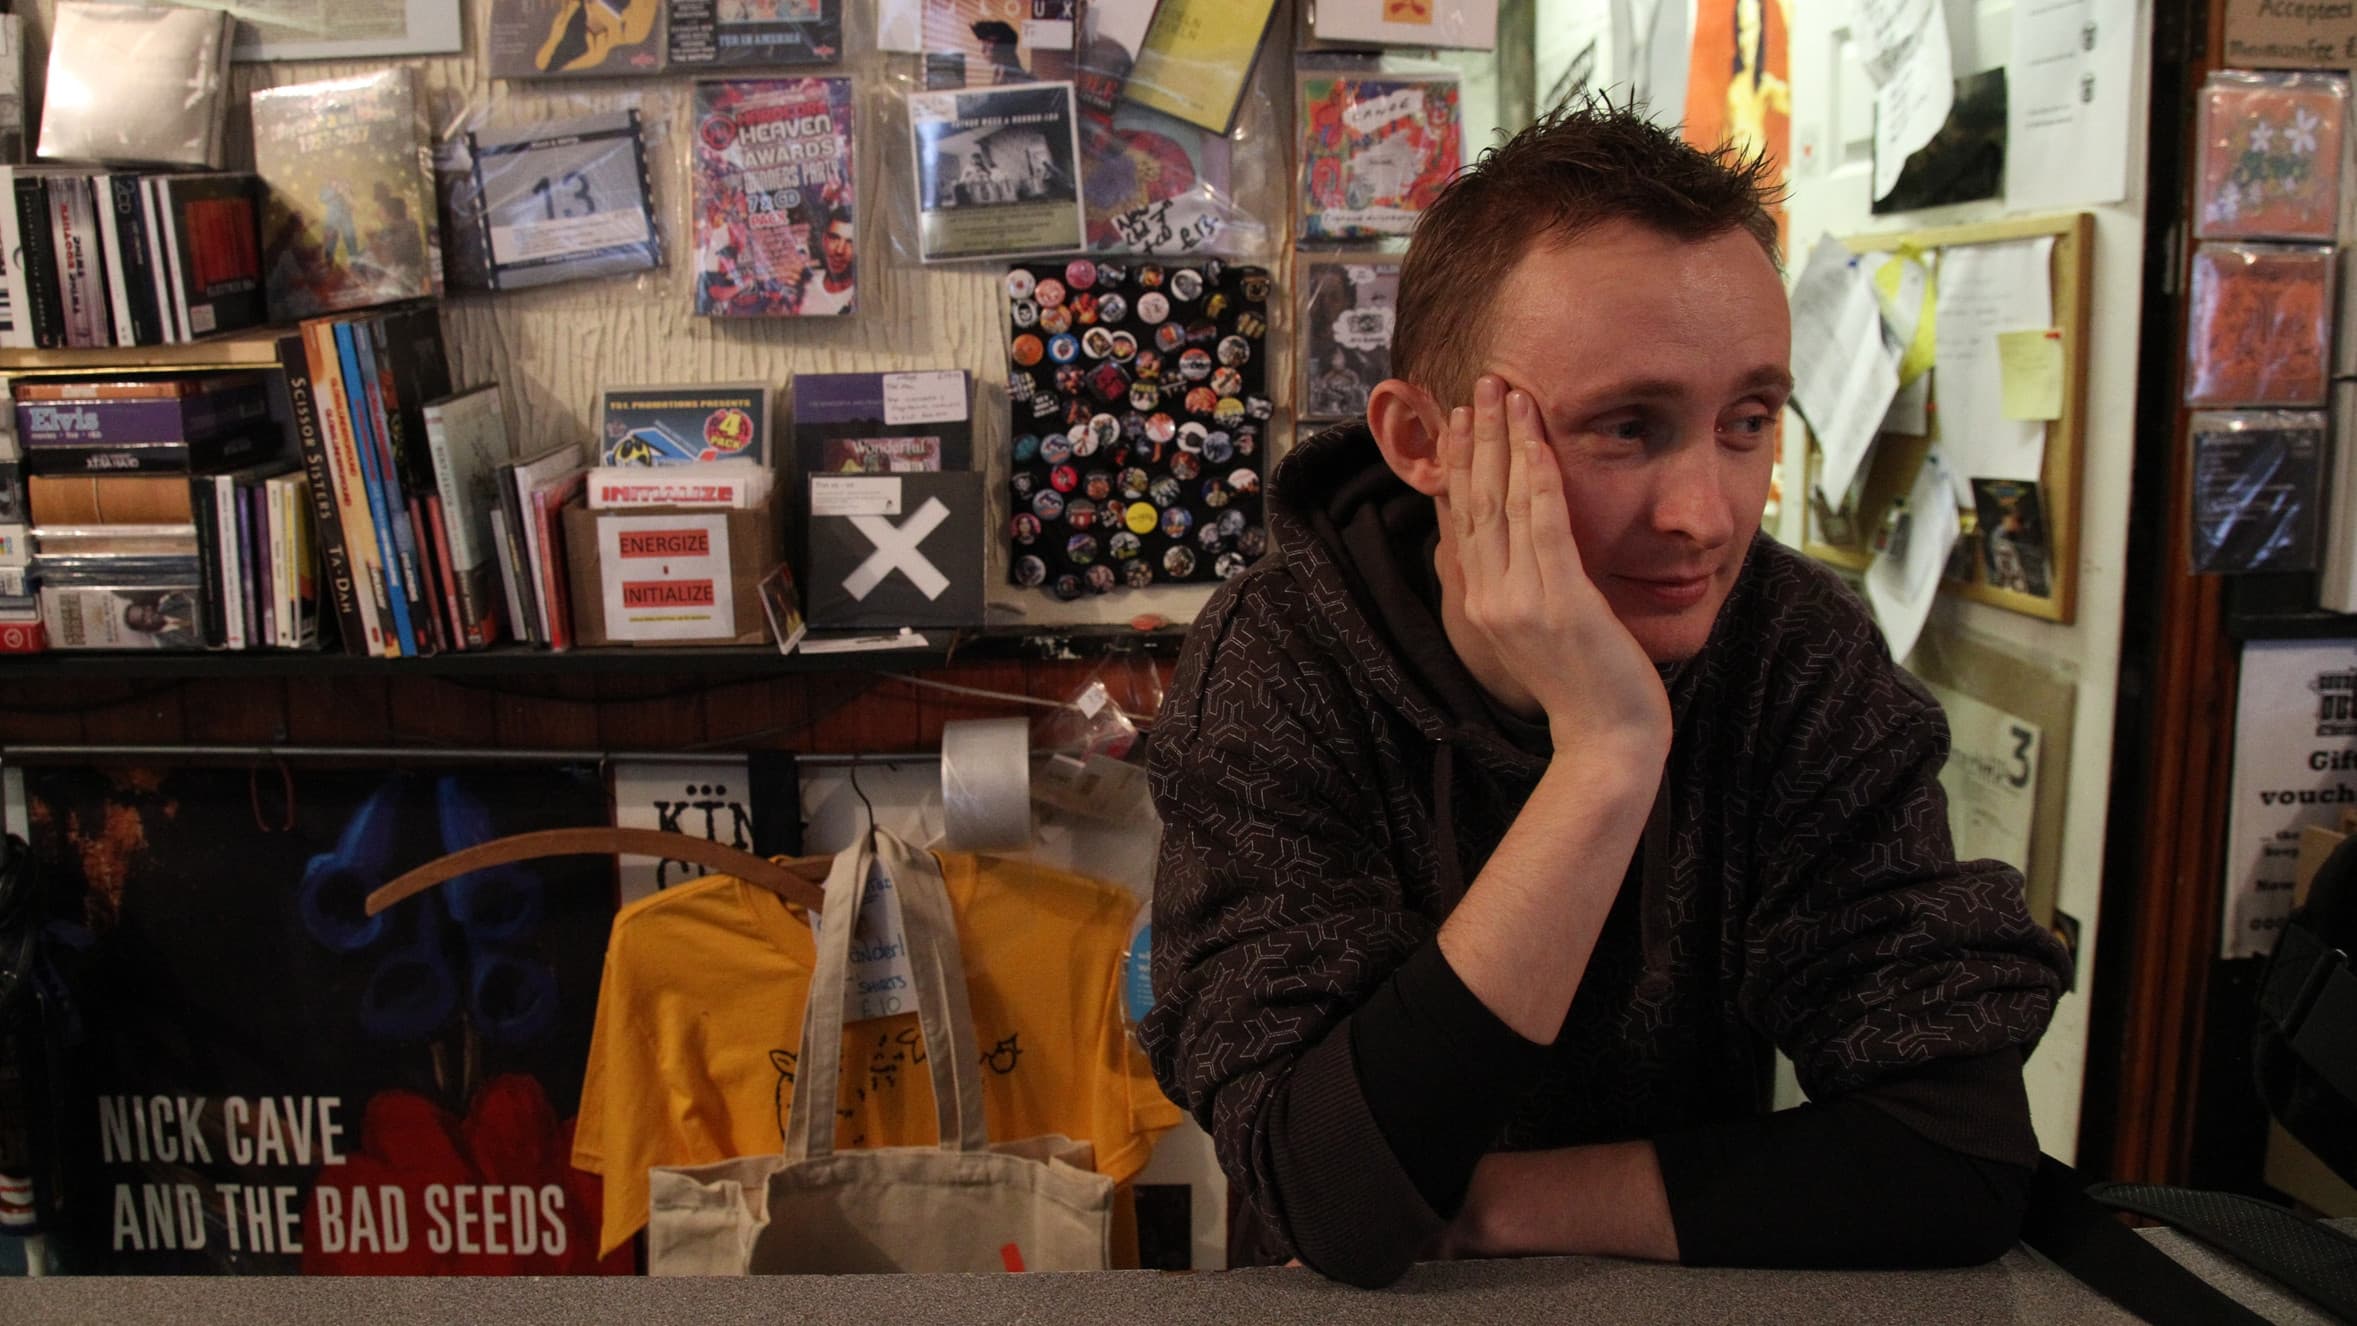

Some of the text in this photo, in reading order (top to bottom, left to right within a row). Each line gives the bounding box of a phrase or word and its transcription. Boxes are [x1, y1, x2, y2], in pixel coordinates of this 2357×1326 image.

[738, 114, 832, 145] HEAVEN
[744, 138, 838, 167] AWARDS
[532, 170, 596, 219] 13
[29, 406, 99, 432] Elvis
[718, 411, 742, 436] 4
[290, 377, 316, 448] SCISSOR
[310, 454, 333, 520] SISTERS
[710, 435, 742, 449] PACK
[853, 437, 926, 456] Wonderful
[620, 535, 709, 554] ENERGIZE
[623, 585, 714, 604] INITIALIZE
[2008, 725, 2033, 790] 3
[98, 1095, 347, 1165] NICK CAVE
[112, 1183, 568, 1255] AND THE BAD SEEDS
